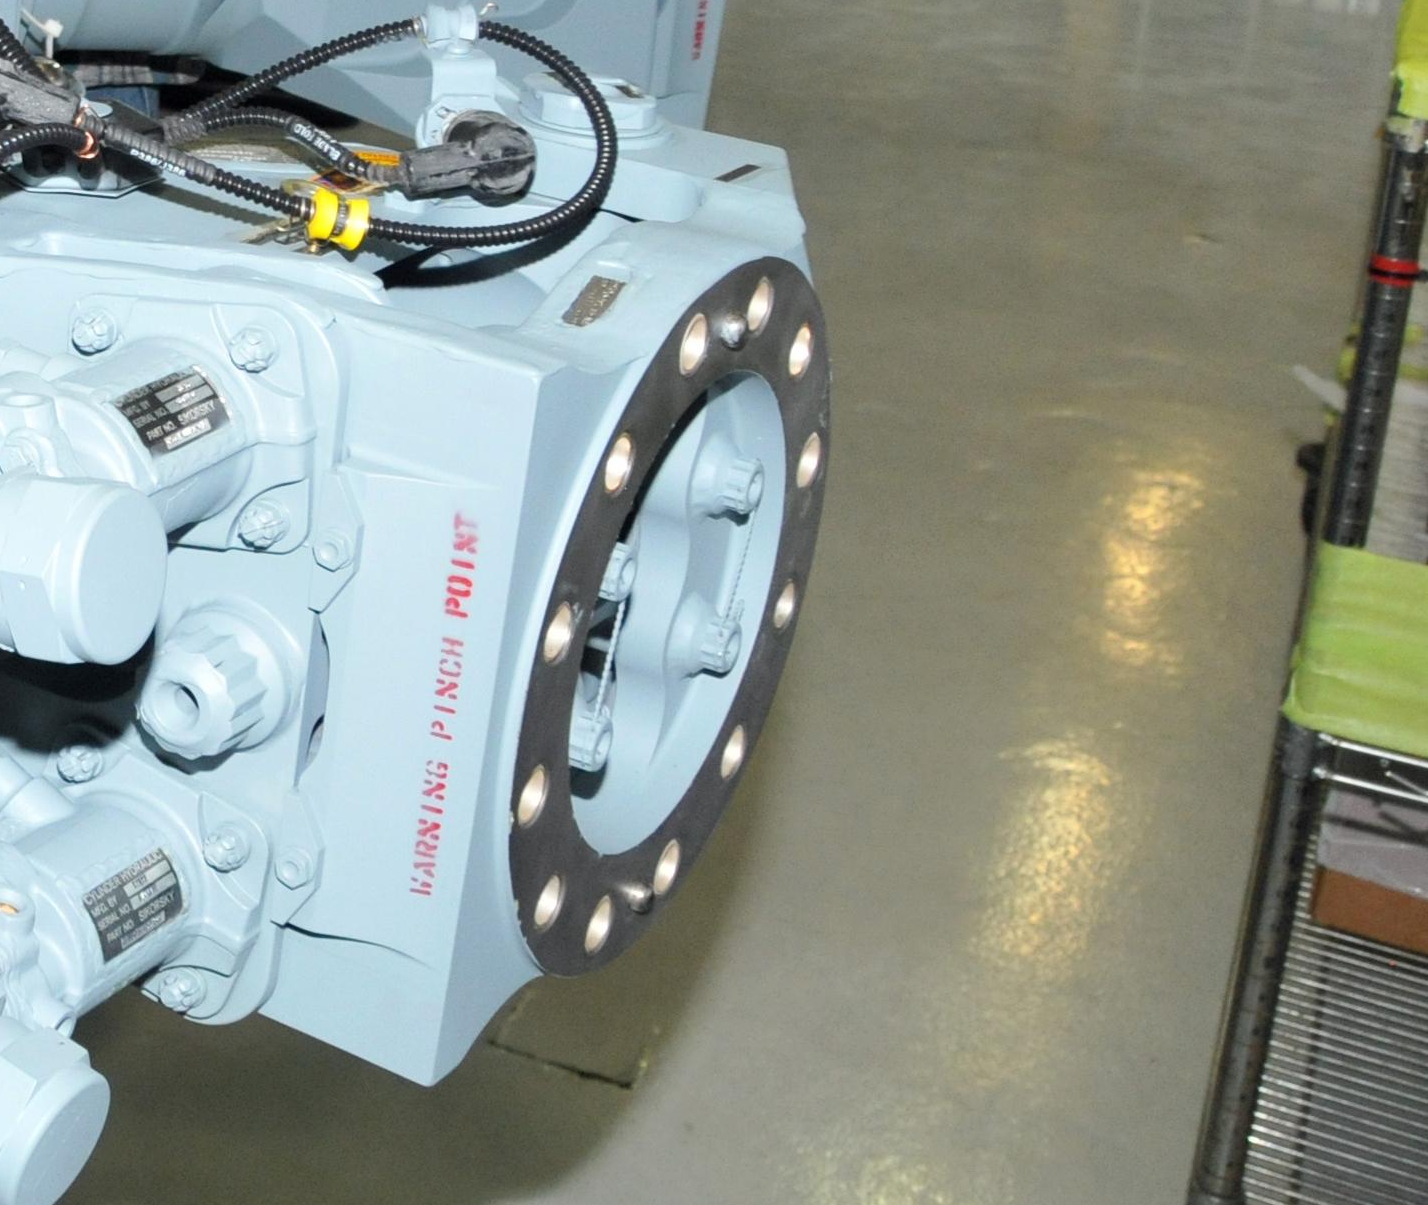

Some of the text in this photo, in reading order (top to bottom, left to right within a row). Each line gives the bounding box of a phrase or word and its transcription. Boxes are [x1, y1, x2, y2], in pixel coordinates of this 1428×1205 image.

[409, 510, 480, 897] WARNING PINCH POINT
[83, 877, 122, 906] CYLINDER
[120, 850, 163, 883] HYDRAULIC
